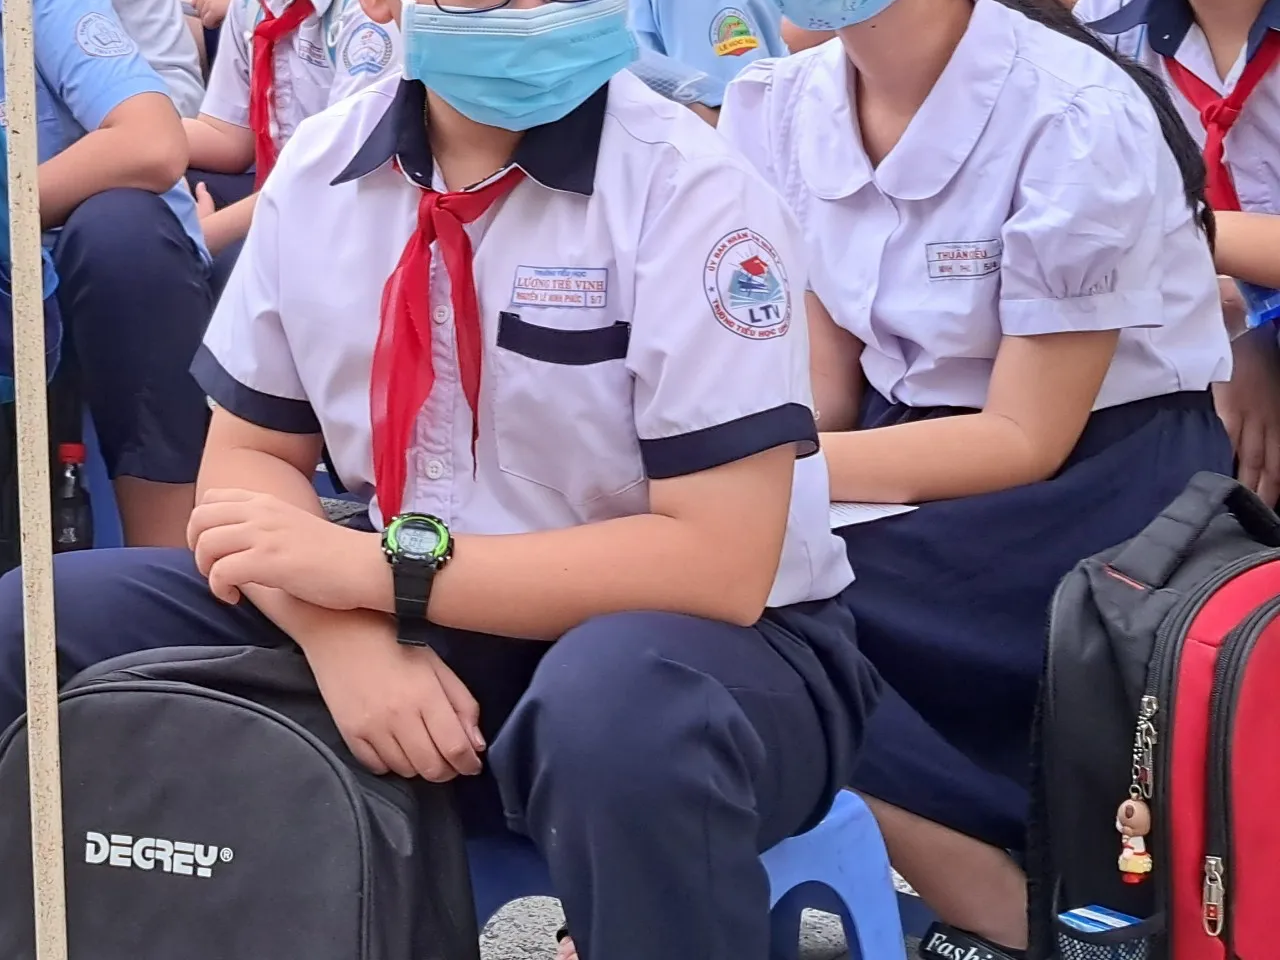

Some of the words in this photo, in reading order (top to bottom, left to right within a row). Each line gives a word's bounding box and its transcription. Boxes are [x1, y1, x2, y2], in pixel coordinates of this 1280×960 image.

[713, 242, 728, 259] BAN
[575, 280, 605, 291] VINH
[736, 324, 756, 337] TIỂU
[758, 328, 777, 338] HỌC
